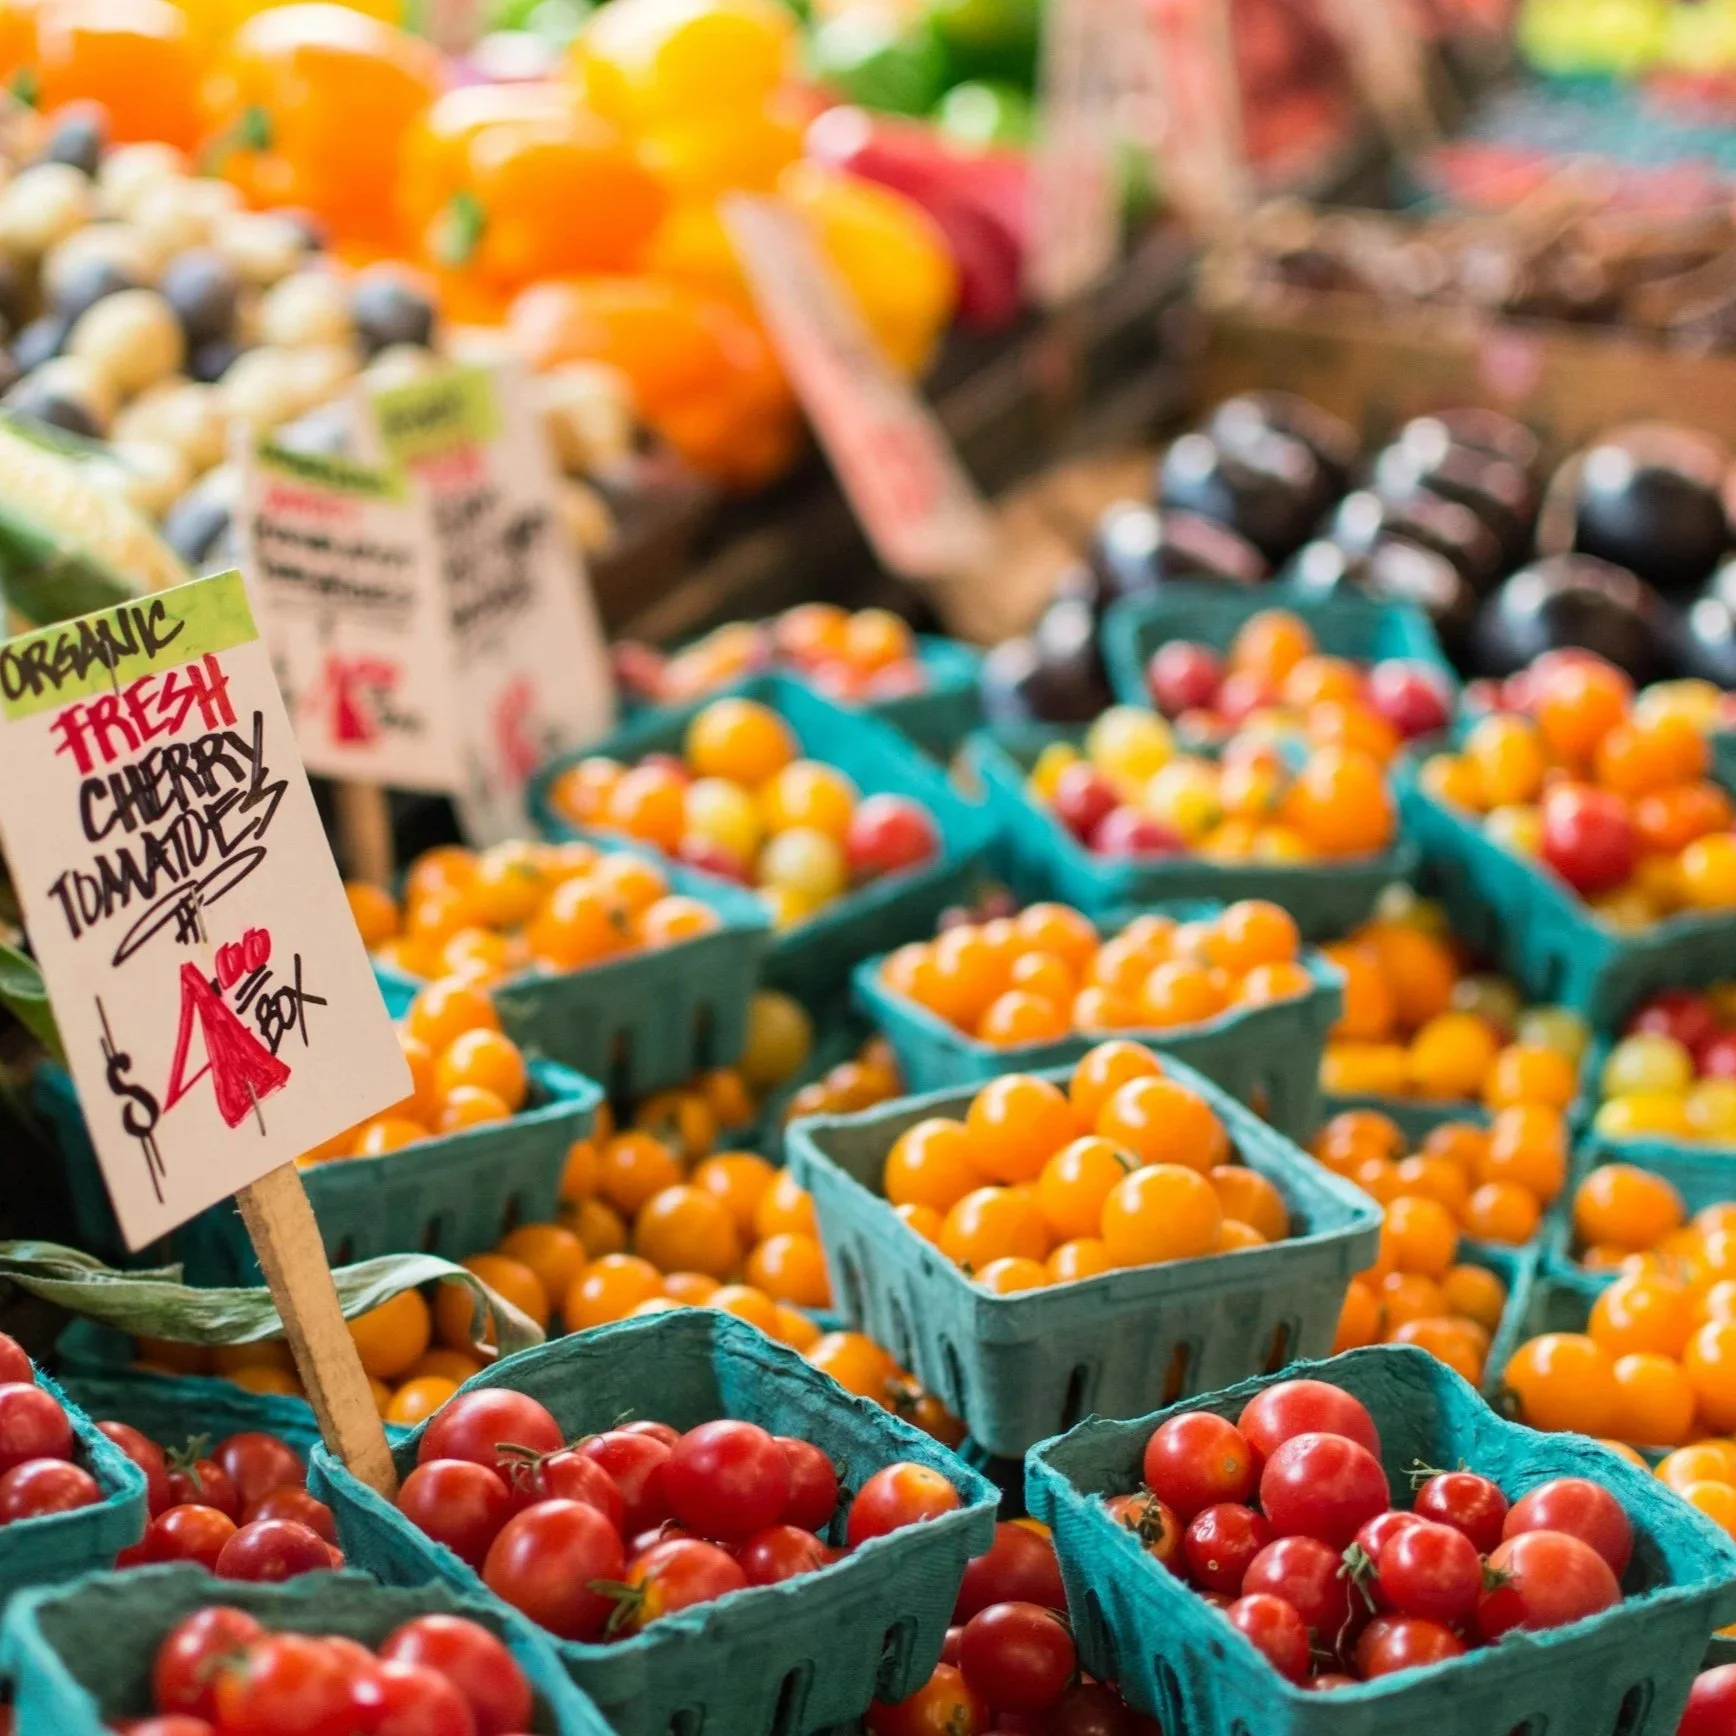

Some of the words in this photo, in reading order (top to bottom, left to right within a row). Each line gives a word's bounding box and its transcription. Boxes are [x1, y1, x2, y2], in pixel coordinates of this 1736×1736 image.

[0, 600, 185, 701] ORGANIC
[49, 653, 238, 776] FRESH
[80, 711, 263, 842] CHERRY
[48, 767, 288, 939] TOMATOES
[255, 953, 328, 1055] BOX
